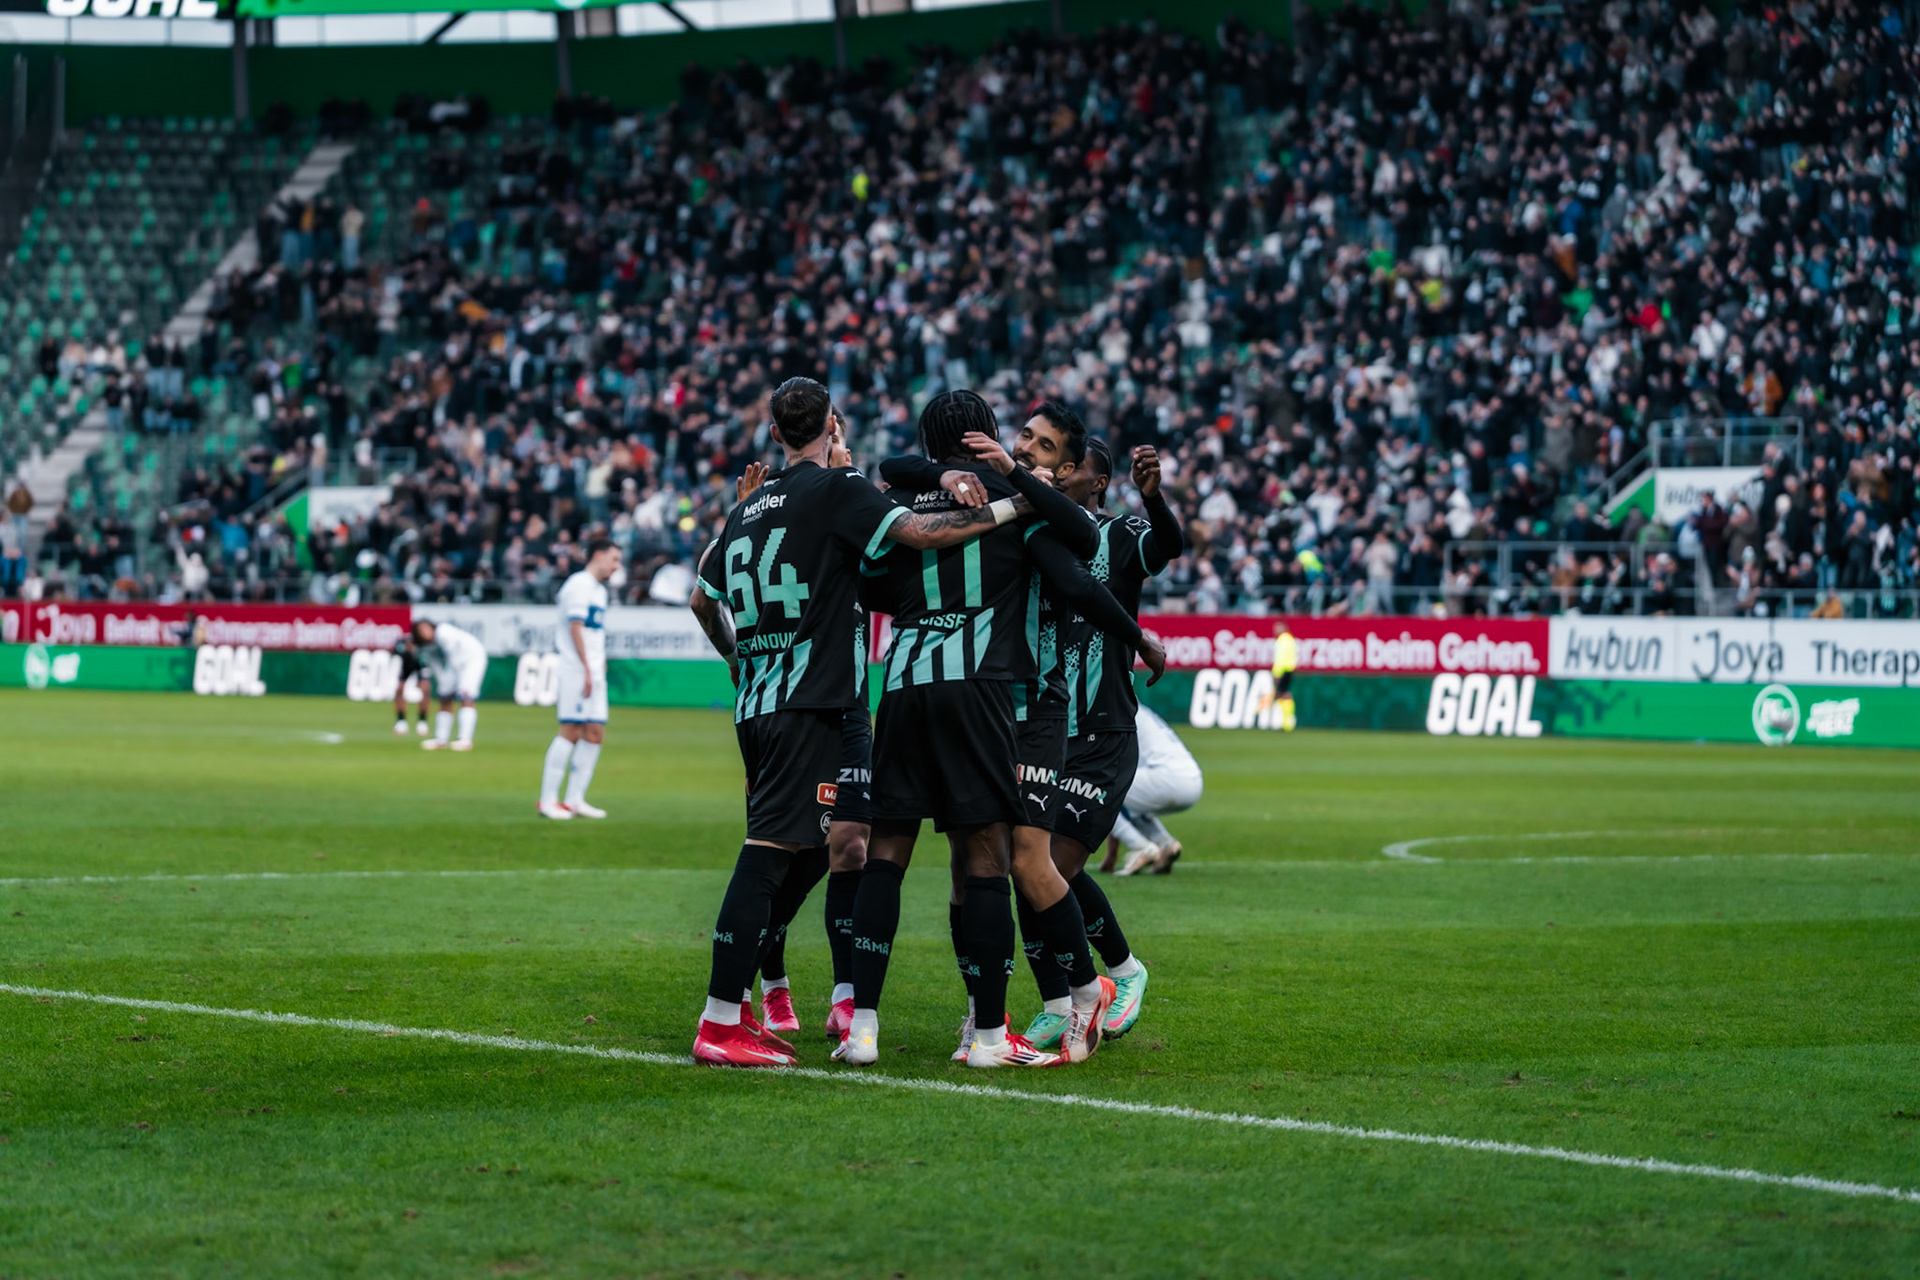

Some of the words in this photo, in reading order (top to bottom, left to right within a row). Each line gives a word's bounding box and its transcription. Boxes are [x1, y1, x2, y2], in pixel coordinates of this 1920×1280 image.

[743, 493, 787, 518] Mettler
[914, 489, 957, 503] Mett
[725, 527, 810, 630] 64
[35, 604, 97, 646] Joya
[193, 645, 267, 697] GOAL
[1366, 631, 1436, 670] beim
[1438, 632, 1541, 672] Gehen.
[1564, 627, 1662, 671] kybun
[1691, 629, 1784, 685] Joya
[1189, 668, 1285, 730] GOA
[1426, 672, 1543, 738] GOAL
[1019, 764, 1058, 786] IMA
[854, 936, 890, 956] ZÄMÄ
